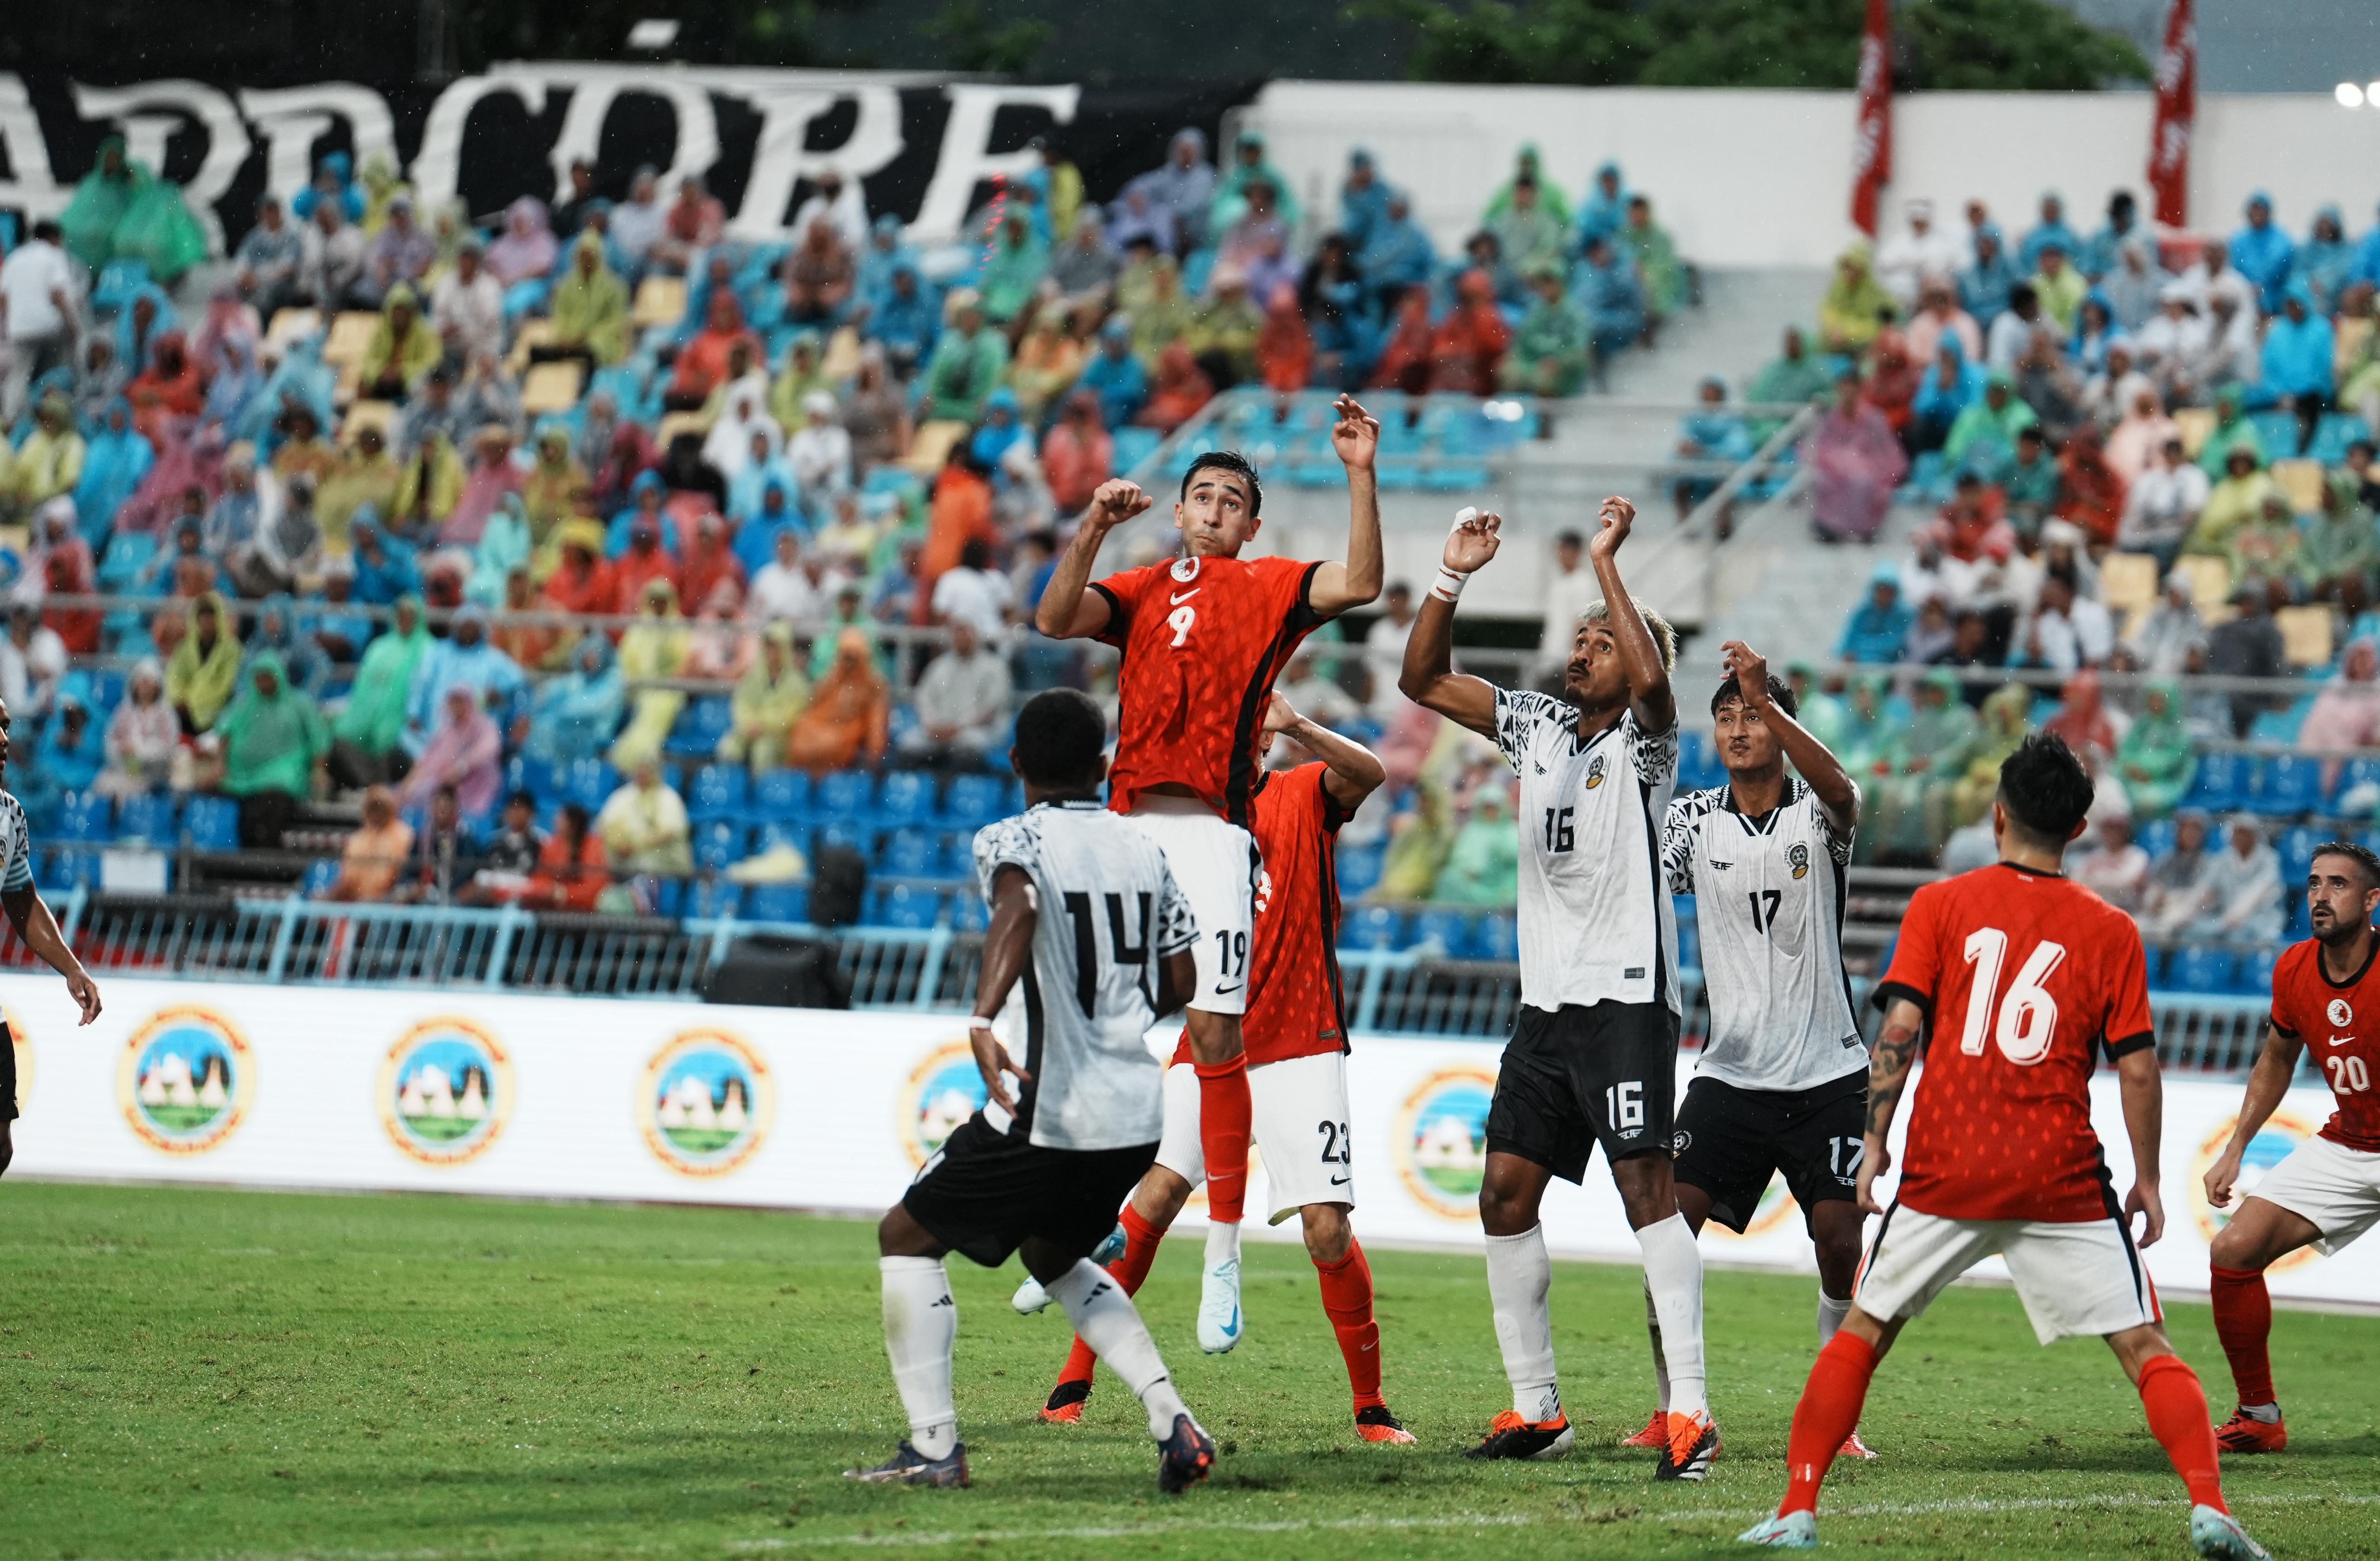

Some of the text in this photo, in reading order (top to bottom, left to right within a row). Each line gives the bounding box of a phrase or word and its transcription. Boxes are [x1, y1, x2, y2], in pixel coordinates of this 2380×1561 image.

[1546, 806, 1574, 853] 16
[1749, 890, 1781, 935] 17
[1063, 891, 1152, 1020] 14
[1216, 930, 1246, 979] 19
[1960, 926, 2066, 1066] 16
[2327, 1055, 2371, 1095] 20
[1606, 1081, 1644, 1131] 16
[1318, 1120, 1350, 1167] 23
[1829, 1136, 1866, 1177] 17
